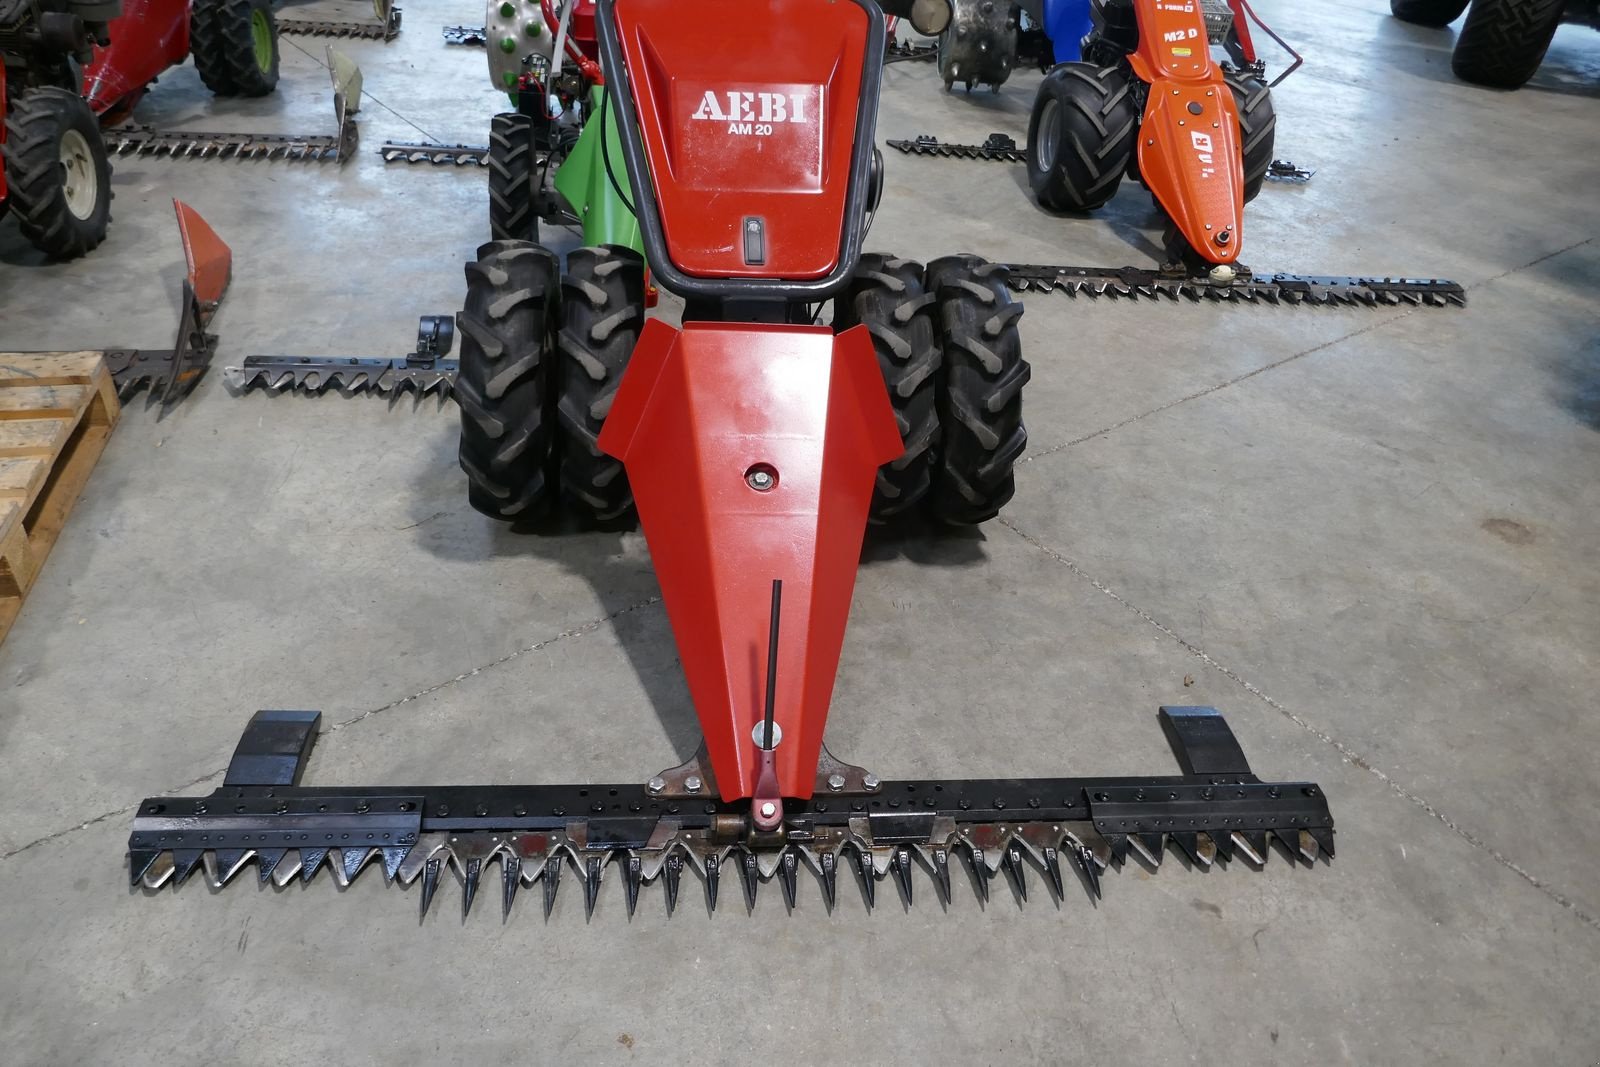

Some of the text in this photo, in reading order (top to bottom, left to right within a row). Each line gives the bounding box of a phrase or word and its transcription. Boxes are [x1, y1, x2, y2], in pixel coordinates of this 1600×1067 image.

[1164, 28, 1198, 42] M2 D
[692, 91, 807, 122] AEBI
[728, 123, 772, 135] AM 20
